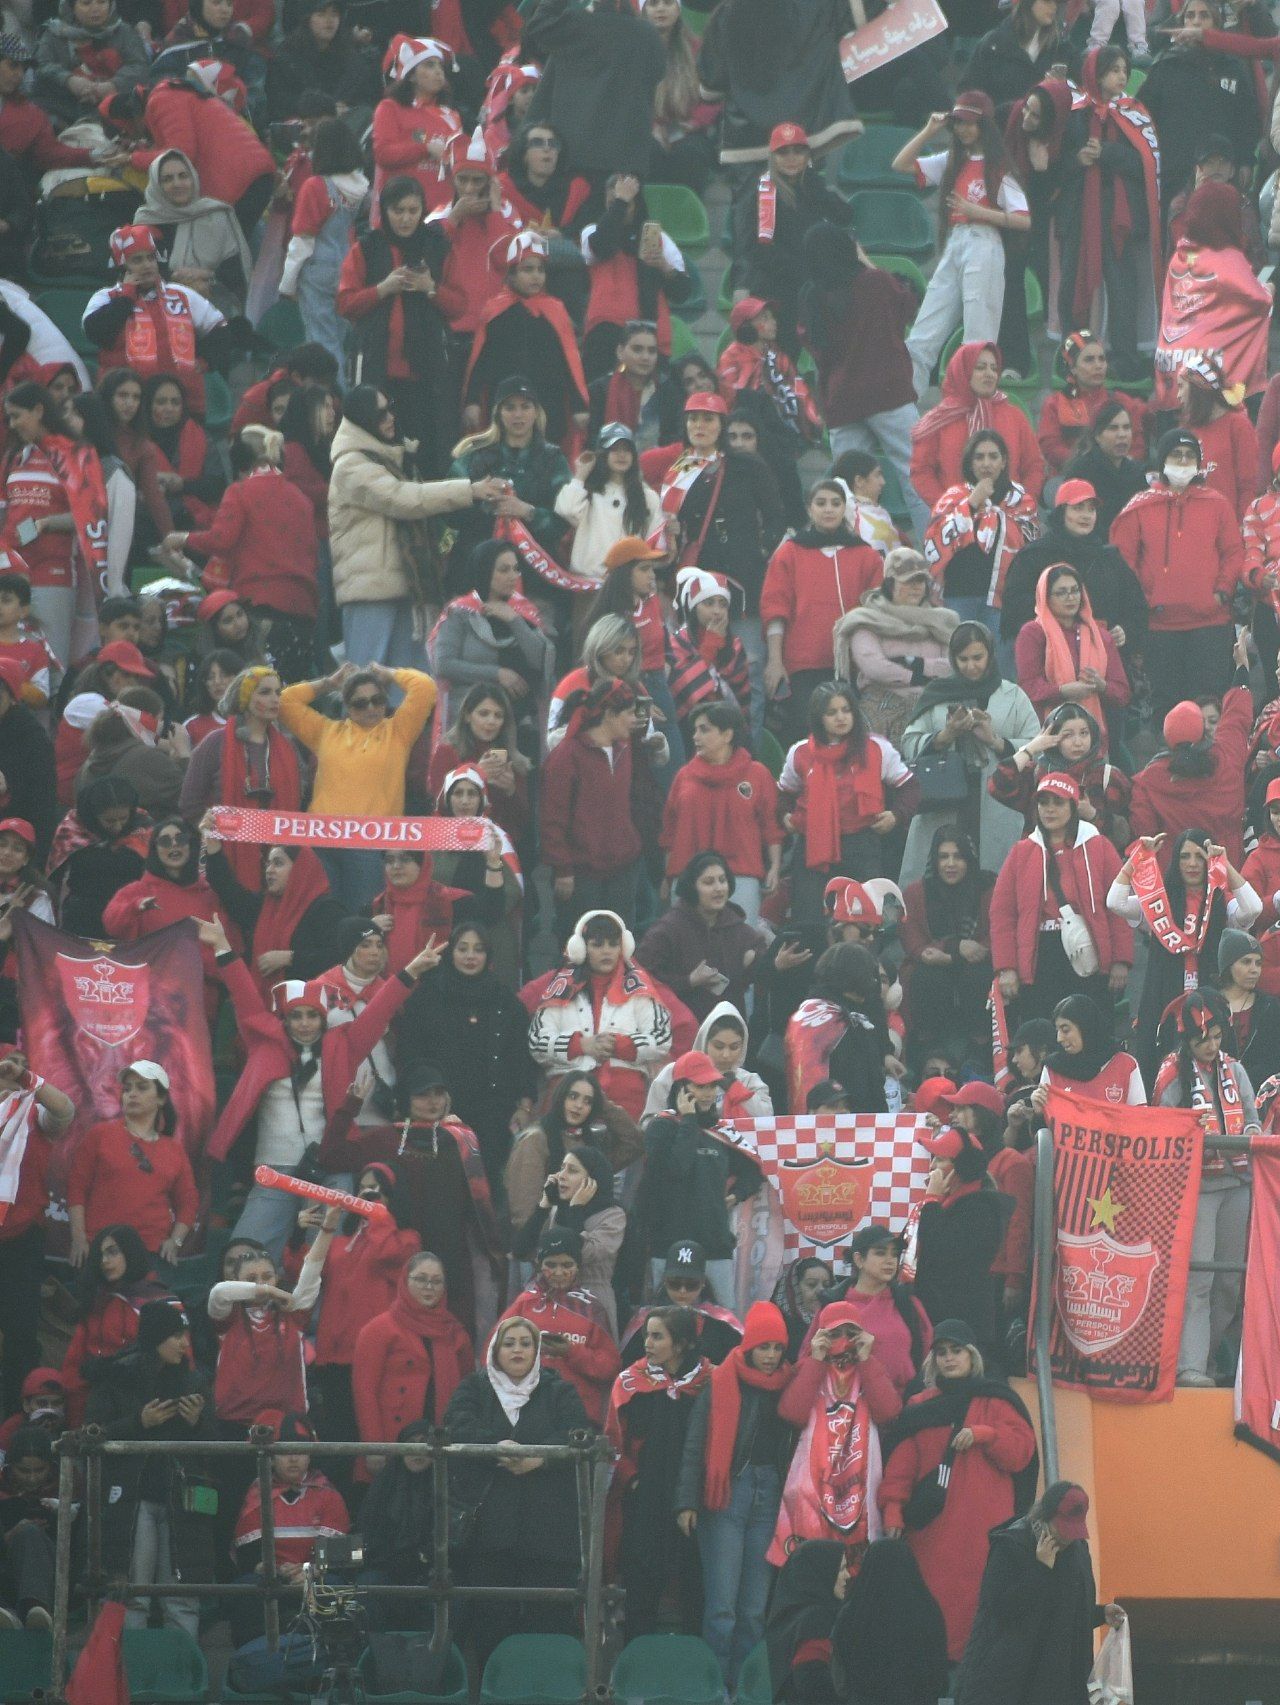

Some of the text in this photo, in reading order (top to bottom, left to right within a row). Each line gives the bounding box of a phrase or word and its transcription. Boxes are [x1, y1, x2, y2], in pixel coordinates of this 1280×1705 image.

[273, 816, 423, 842] PERSPOLIS
[1059, 1122, 1186, 1160] PERSPOLIS
[289, 1178, 376, 1213] PERSEPOLIS
